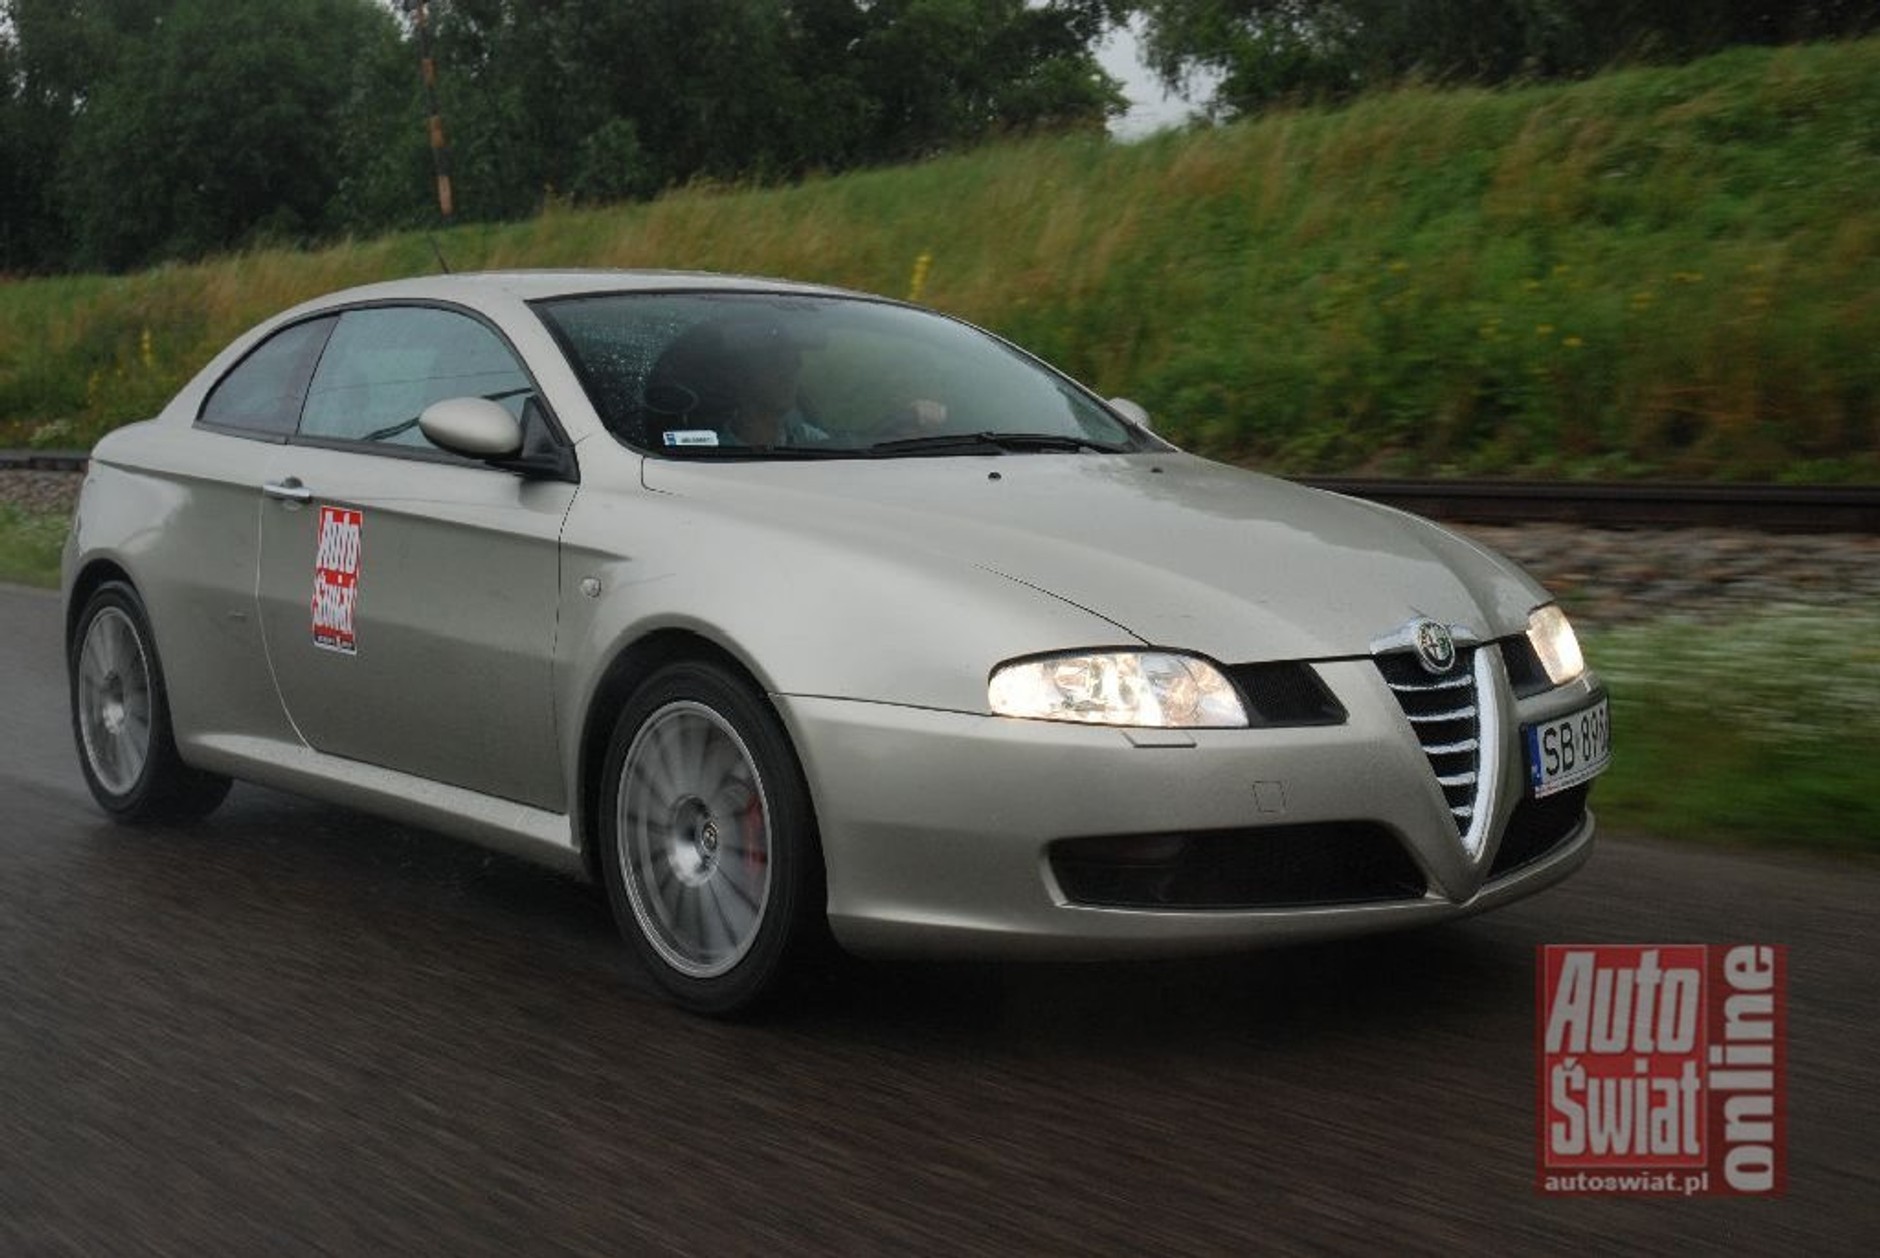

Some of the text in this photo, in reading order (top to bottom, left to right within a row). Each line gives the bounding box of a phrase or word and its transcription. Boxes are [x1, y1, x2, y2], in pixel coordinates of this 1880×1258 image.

[316, 510, 360, 574] Auto
[1543, 721, 1575, 776] SB
[1580, 706, 1609, 762] 896
